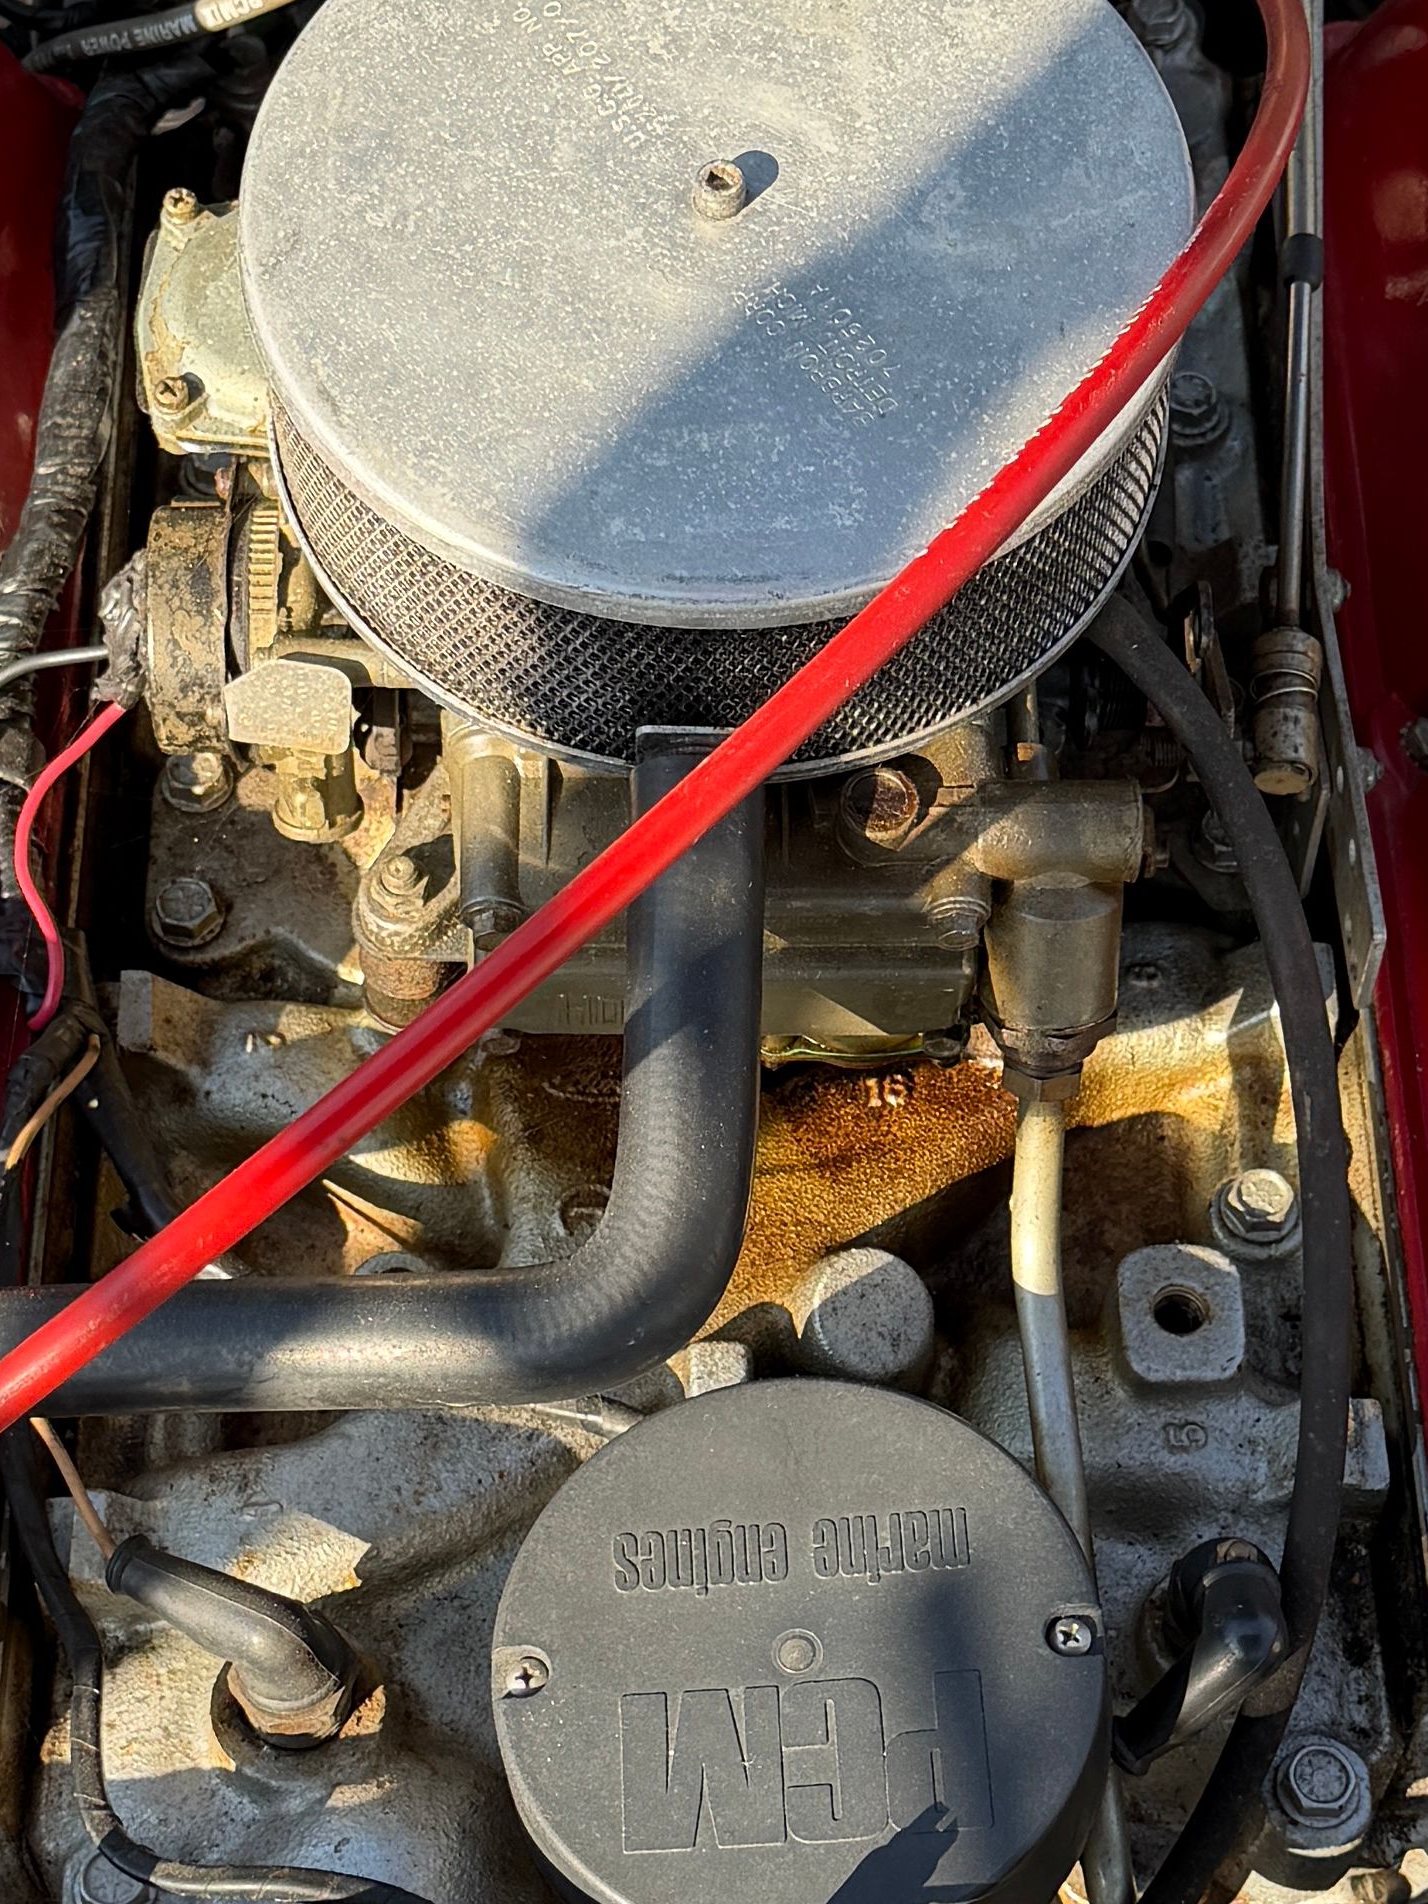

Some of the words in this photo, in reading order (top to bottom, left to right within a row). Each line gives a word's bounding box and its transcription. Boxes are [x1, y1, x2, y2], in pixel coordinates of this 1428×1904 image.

[80, 29, 131, 55] POWER
[133, 13, 197, 46] MARINE
[508, 1, 542, 35] NO.
[614, 1518, 788, 1597] engines
[812, 1507, 970, 1584] marine
[617, 1668, 995, 1854] PCM
